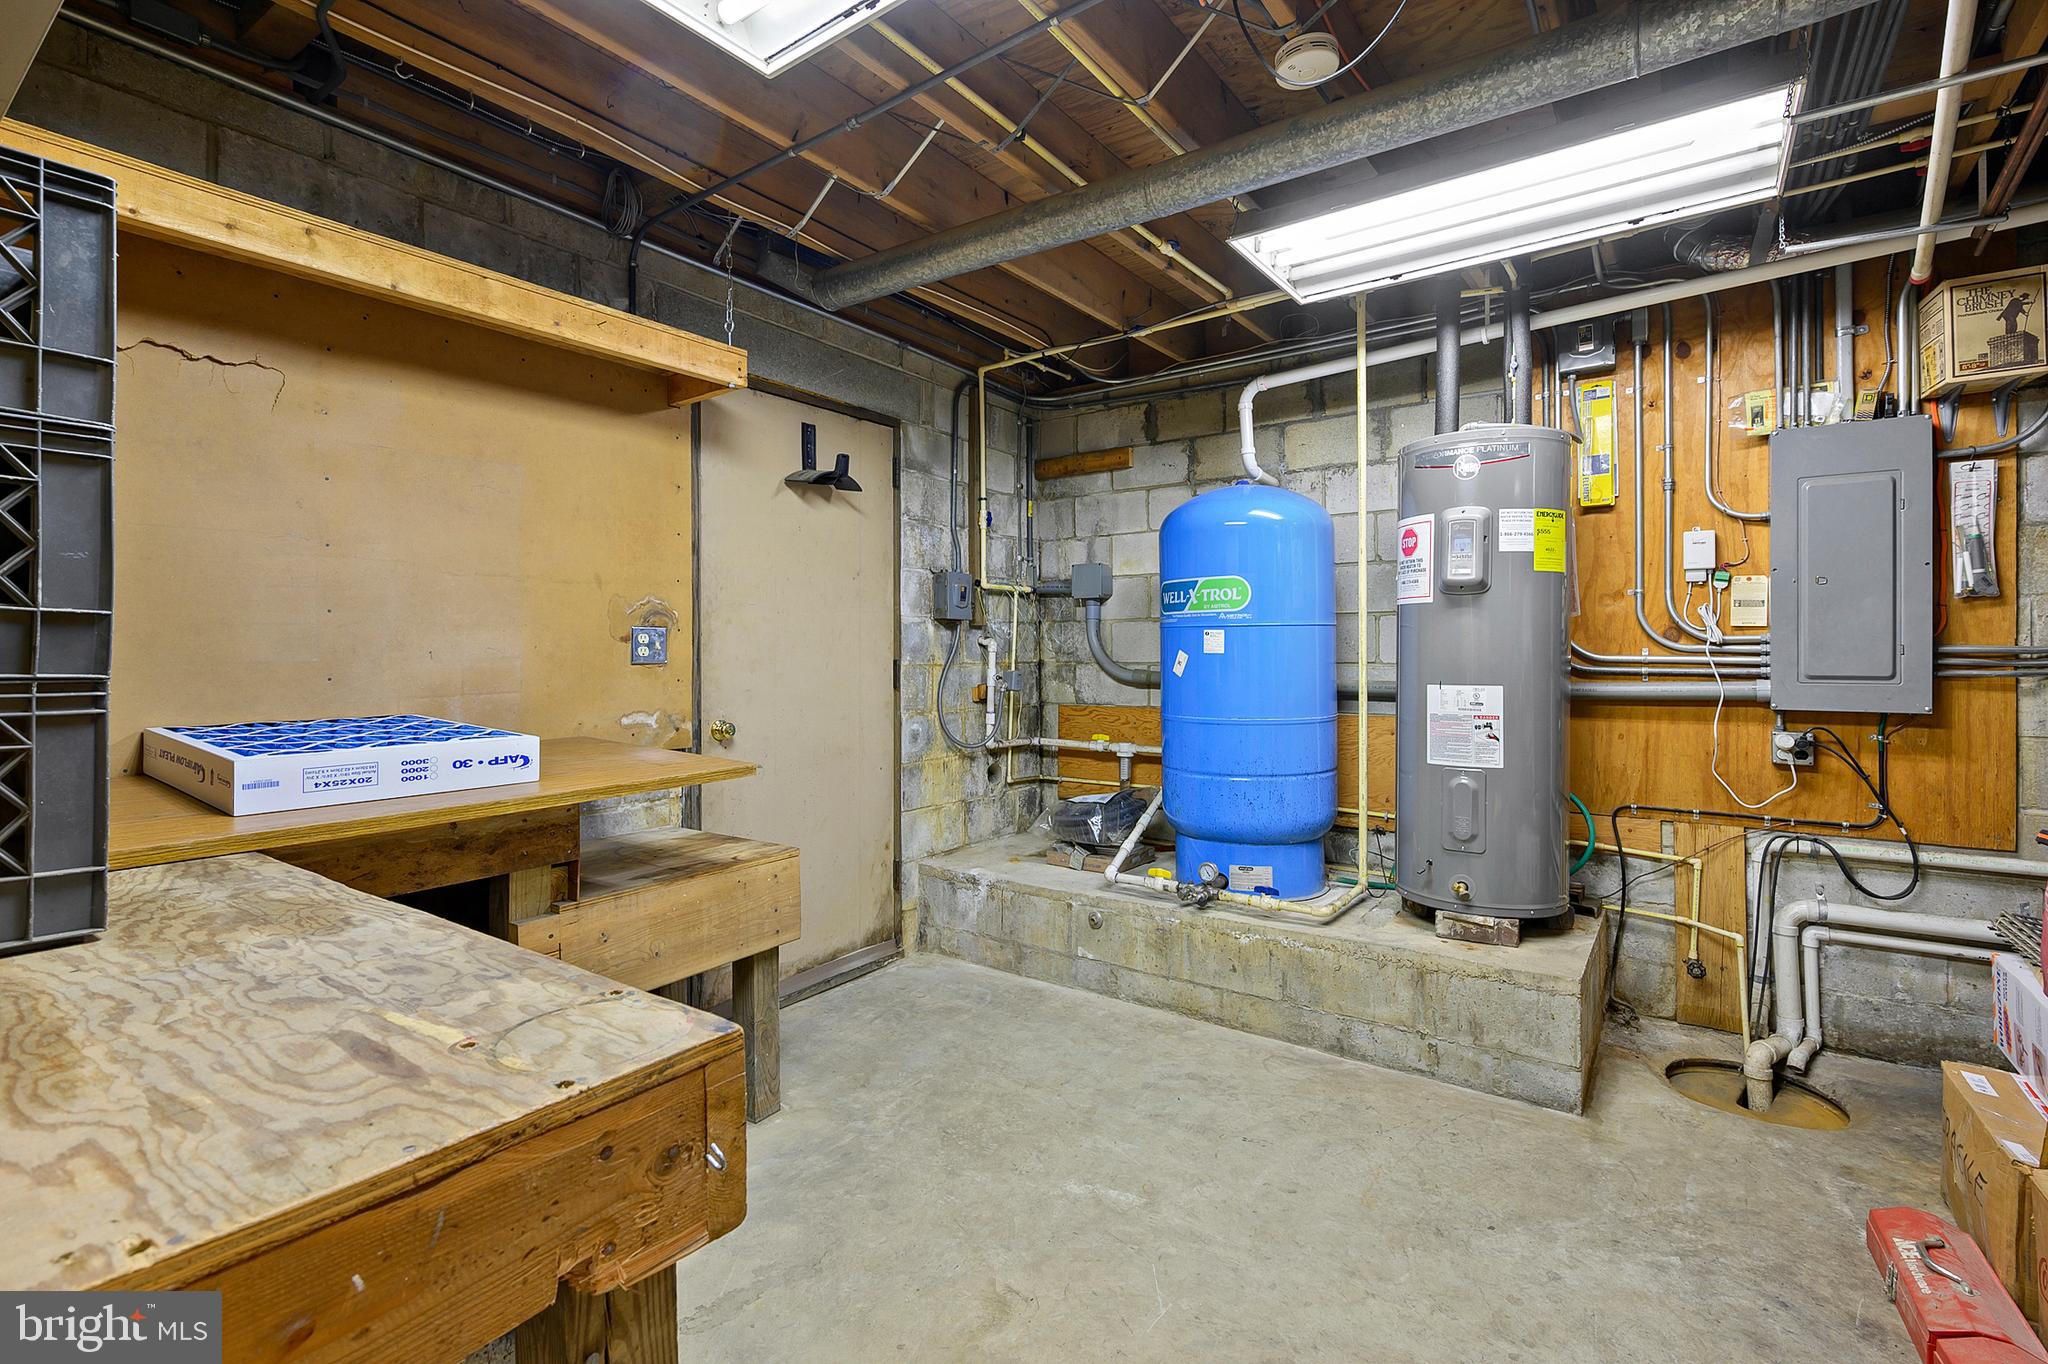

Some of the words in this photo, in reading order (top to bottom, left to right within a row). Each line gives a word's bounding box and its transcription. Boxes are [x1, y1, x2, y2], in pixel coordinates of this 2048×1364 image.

[1957, 289, 2016, 306] CHIMNEY
[1966, 286, 1992, 297] THE
[1965, 299, 2003, 312] BRUSH
[1476, 444, 1520, 454] PLATINUM
[1402, 537, 1417, 549] STOP
[401, 758, 429, 766] 3000
[452, 759, 473, 769] 30
[401, 766, 429, 774] 2000
[314, 776, 373, 788] 20X25X4
[401, 774, 429, 782] 1000
[1943, 1107, 1988, 1208] RAGILE
[1892, 1237, 1921, 1259] ACE
[1905, 1260, 1931, 1294] Hardware
